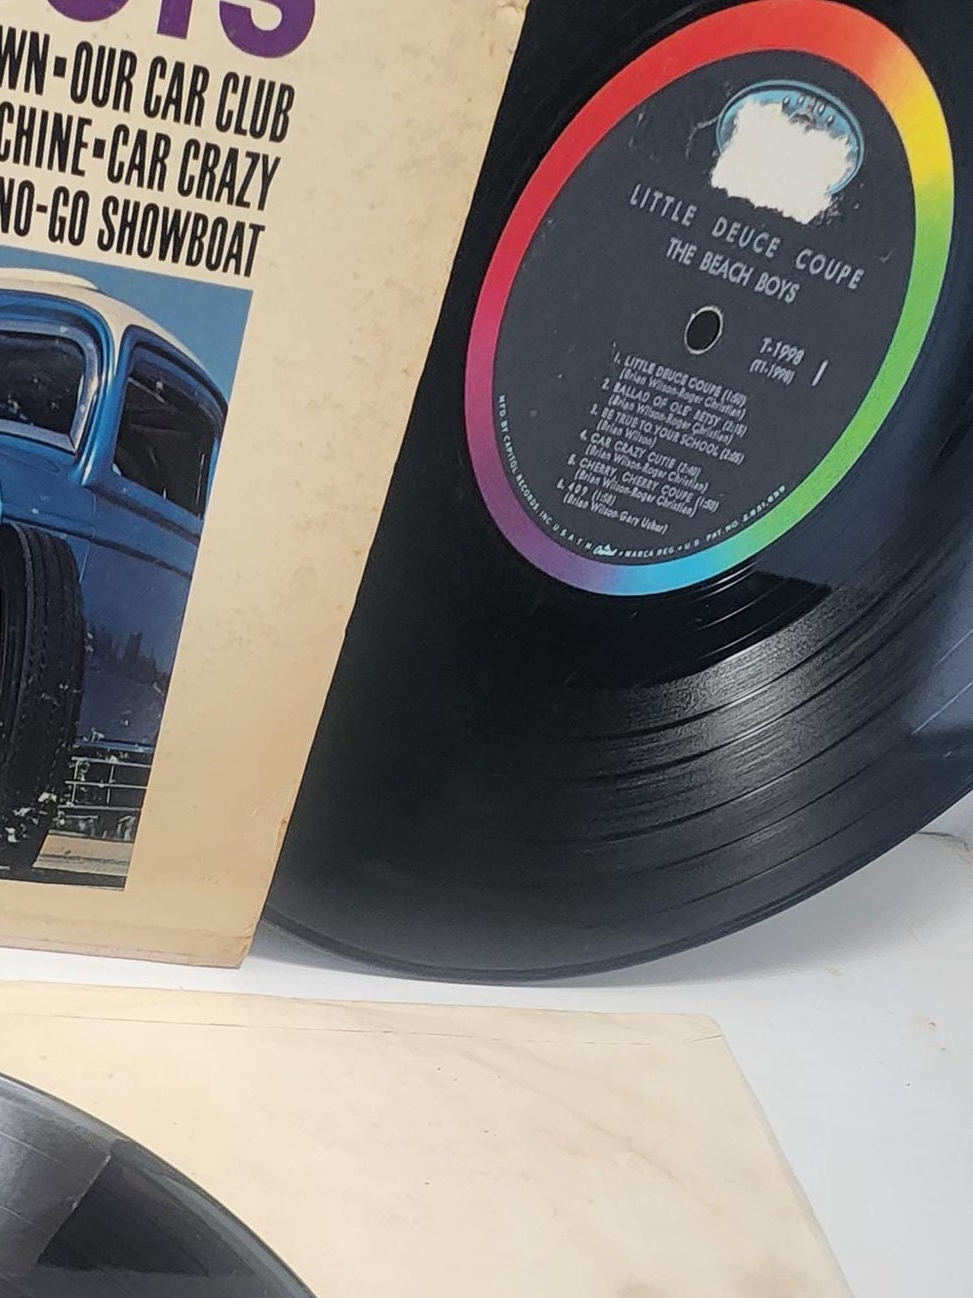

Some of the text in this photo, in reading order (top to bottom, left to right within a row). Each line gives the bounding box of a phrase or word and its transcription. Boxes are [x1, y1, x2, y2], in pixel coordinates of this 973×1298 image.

[70, 41, 137, 114] OUR
[144, 55, 210, 127] CAR
[215, 71, 295, 143] CLUB
[107, 123, 171, 192] CAR
[178, 138, 281, 211] CRAZY
[97, 195, 265, 278] SHOWBOAT
[629, 183, 865, 290] LITTLE DEUCE COUPE
[666, 237, 800, 304] THE BEACH BOYS
[619, 368, 646, 385] (Brian
[624, 355, 656, 375] LITTLE
[655, 365, 687, 386] DEUCE
[688, 376, 723, 398] COUPE
[607, 394, 634, 410] (Brian
[612, 381, 650, 403] BALLAD
[652, 395, 668, 408] OF
[693, 409, 721, 428] BETSY
[585, 444, 611, 462] (Brian
[590, 432, 611, 449] CAR
[614, 440, 646, 460] CRAZY
[647, 451, 677, 470] CUTIE
[596, 419, 657, 449] (Brian Wilson)
[601, 407, 615, 420] BE
[614, 411, 638, 428] TRUE
[639, 420, 653, 433] TO
[654, 424, 683, 443] YOUR
[680, 434, 719, 457] SCHOOL
[574, 468, 600, 486] (Brian
[621, 471, 660, 492] CHERRY
[660, 484, 694, 504] COUPE
[563, 491, 589, 509] (Brian
[640, 516, 669, 535] Usher)
